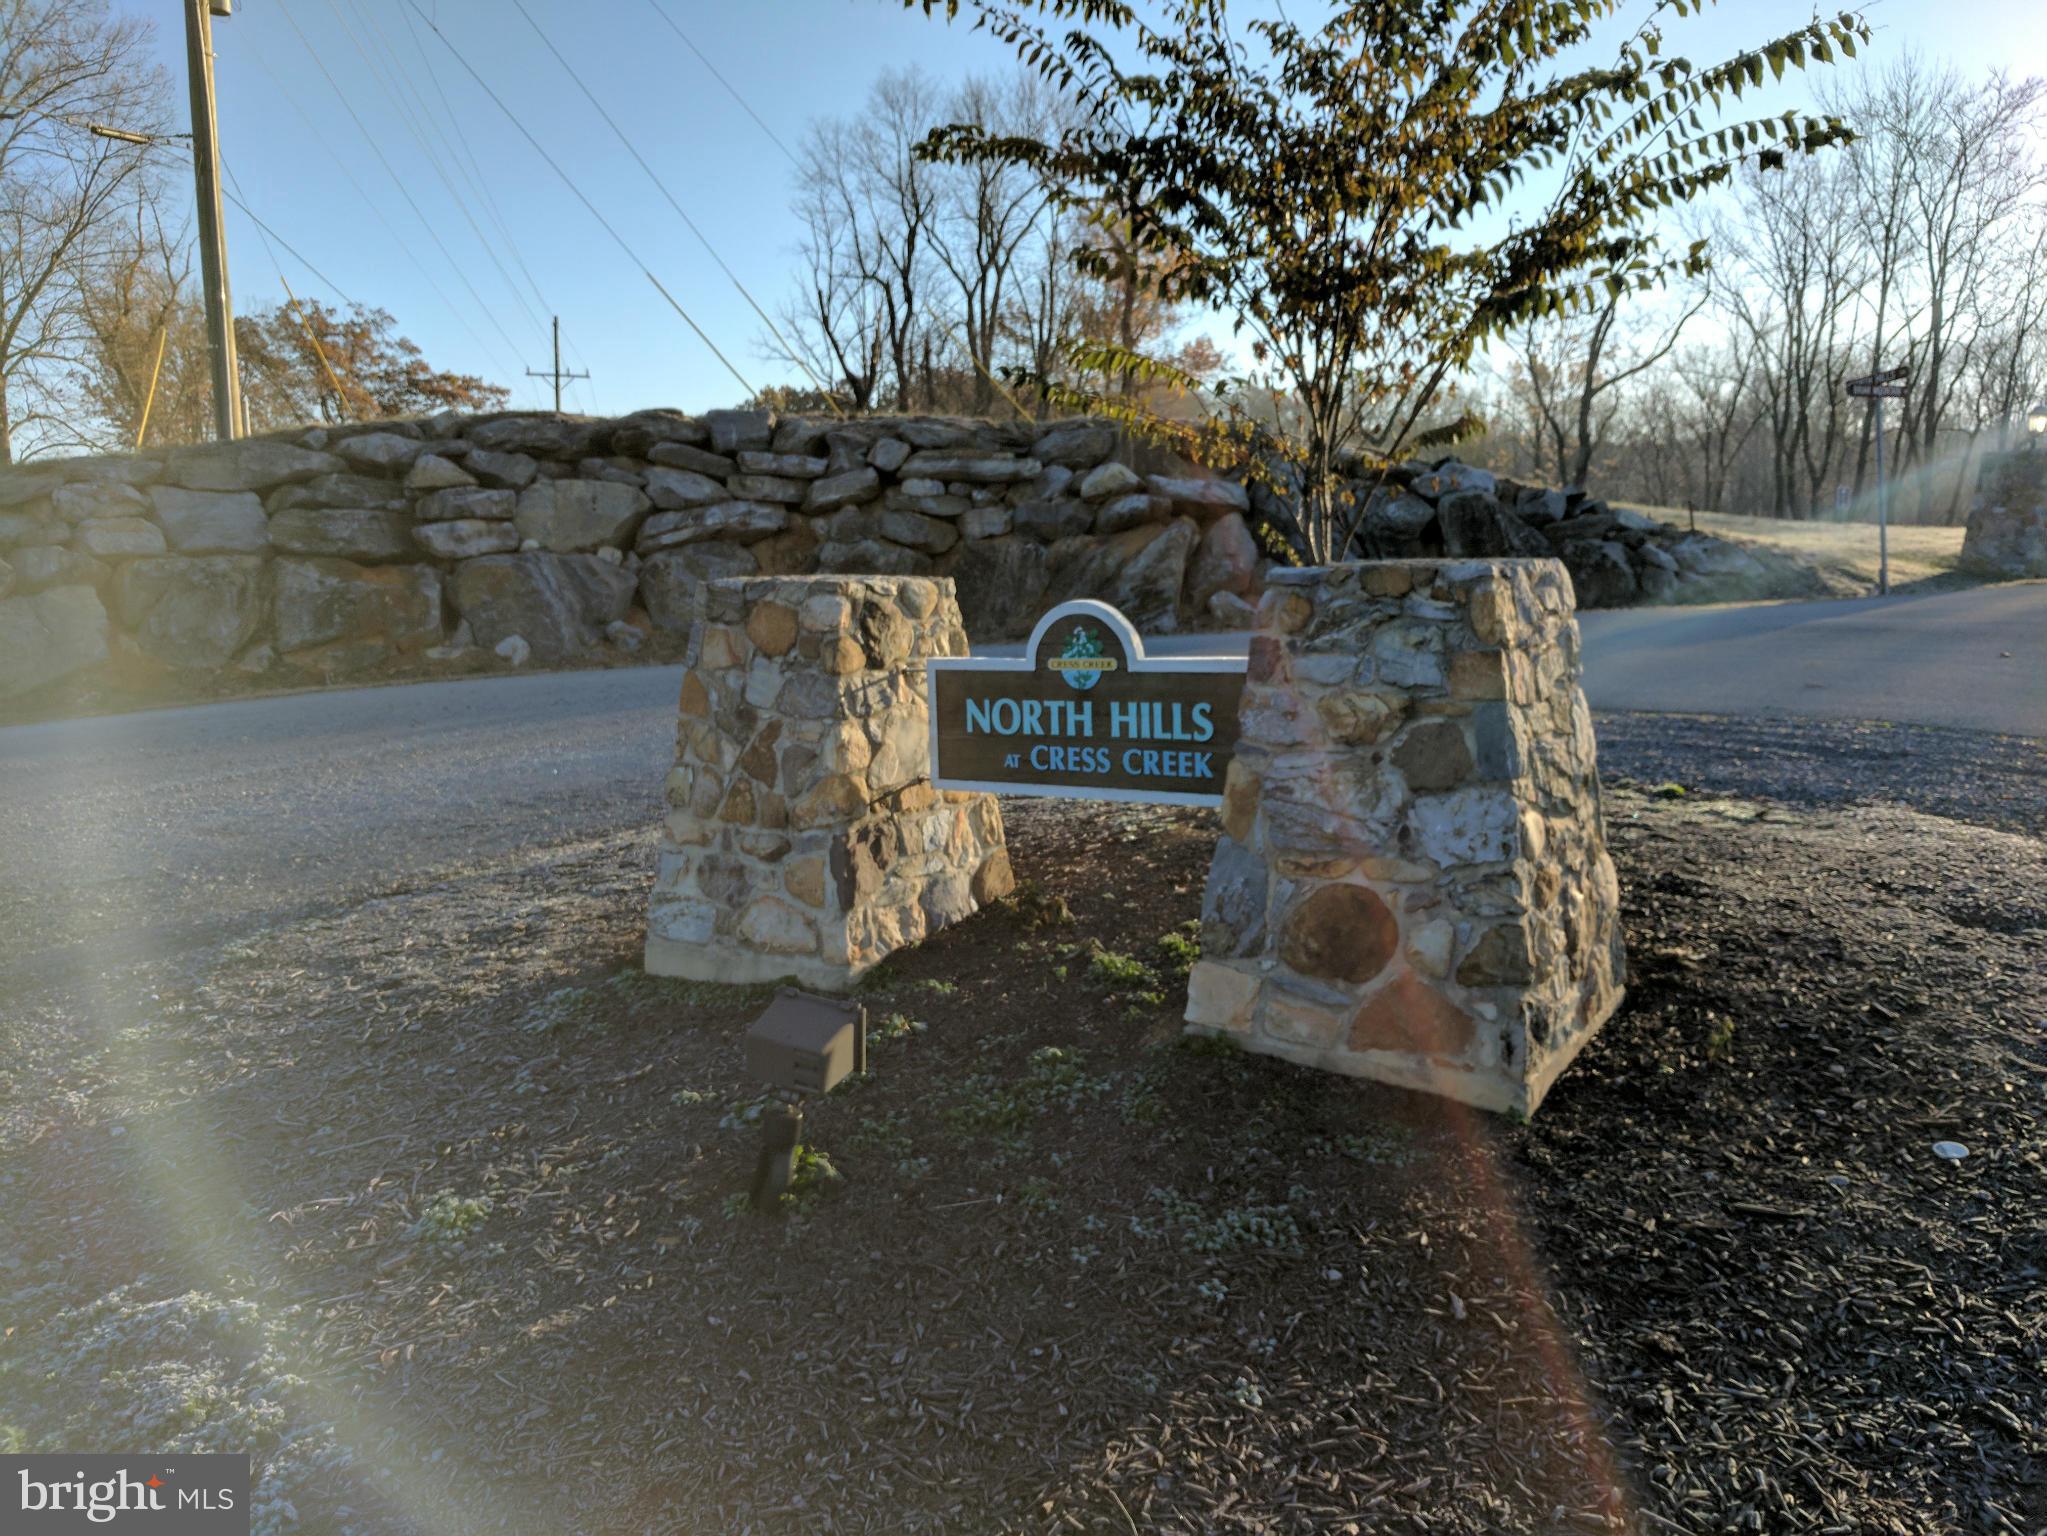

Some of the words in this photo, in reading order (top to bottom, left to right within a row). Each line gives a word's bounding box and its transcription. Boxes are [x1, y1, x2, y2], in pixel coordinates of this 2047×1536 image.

[965, 698, 1093, 737] NORTH
[1110, 701, 1214, 742] HILLS
[1004, 754, 1021, 768] AT
[1030, 745, 1111, 774] CRESS
[1122, 748, 1214, 778] CREEK
